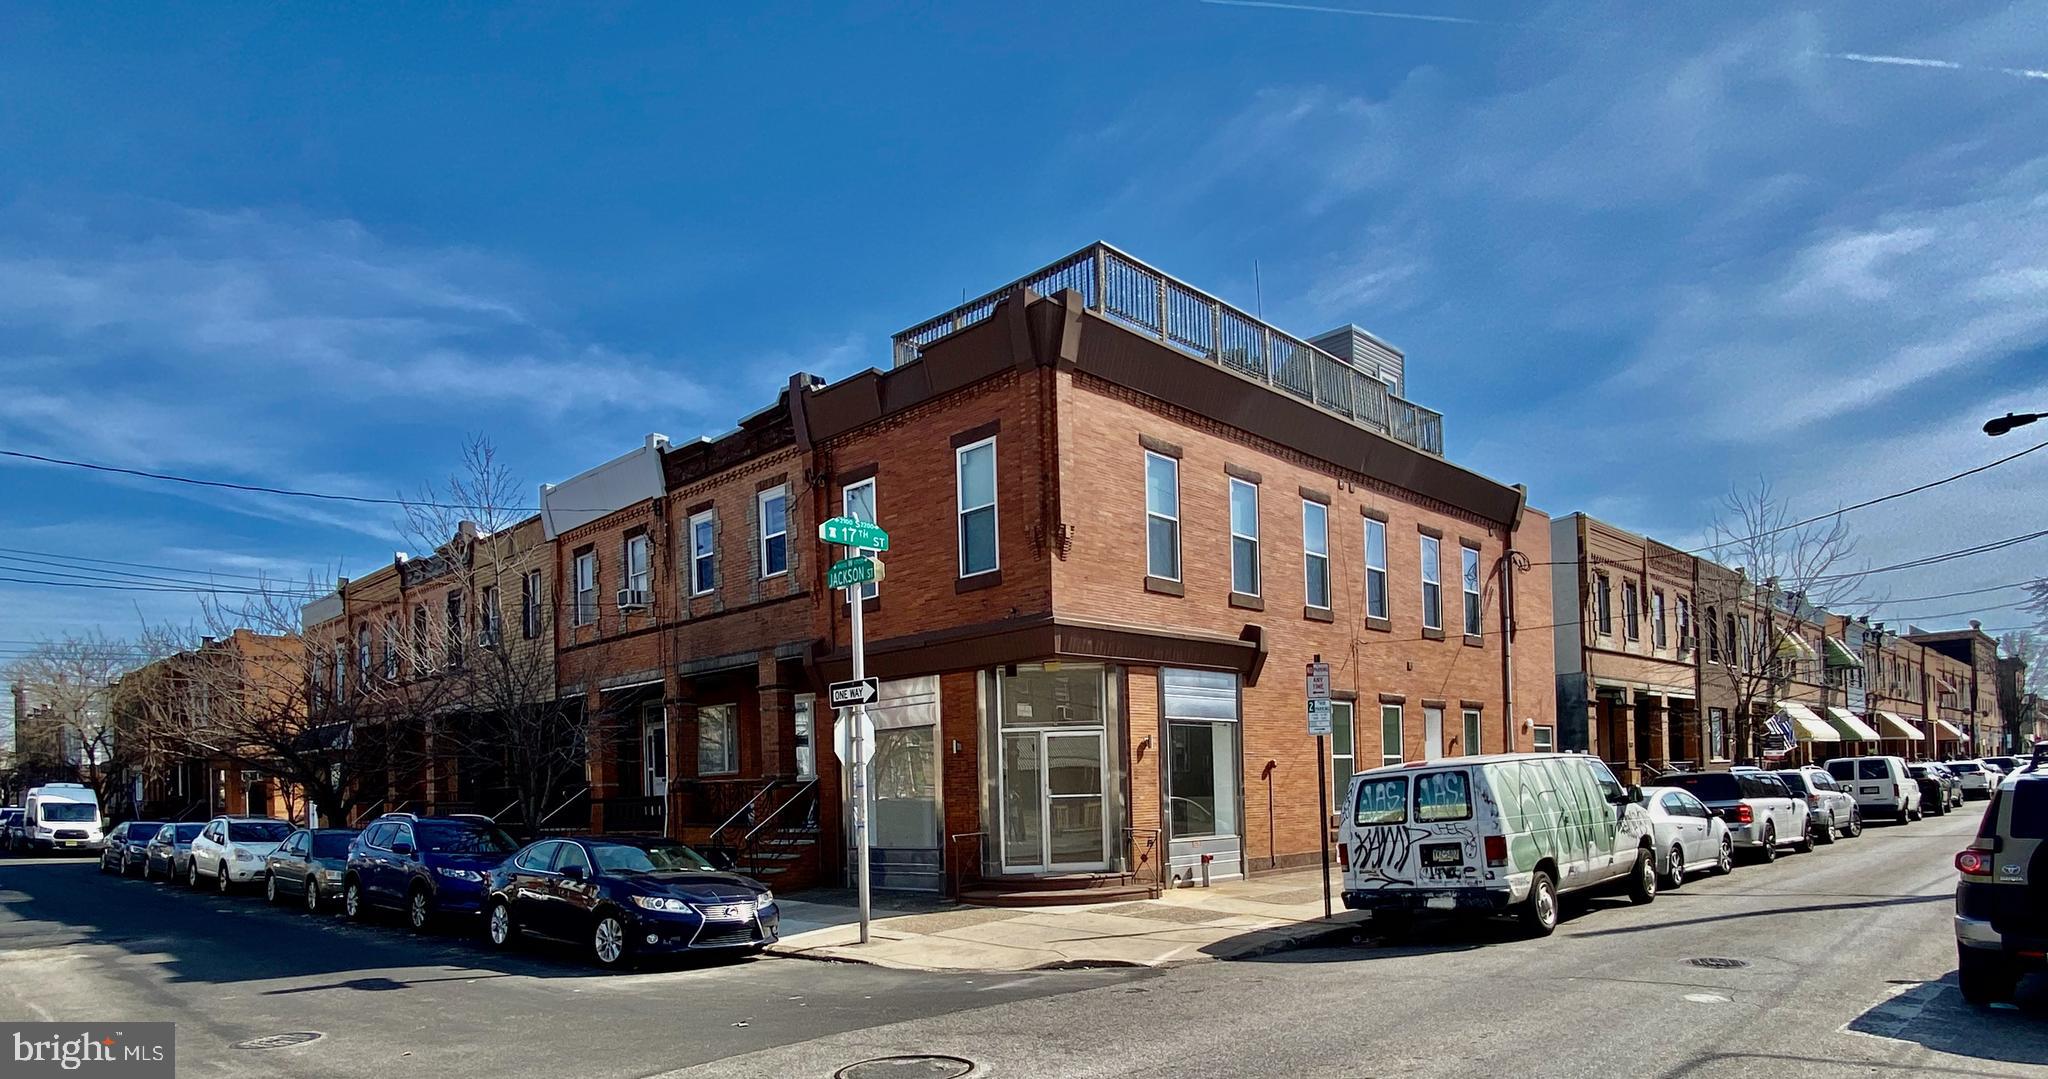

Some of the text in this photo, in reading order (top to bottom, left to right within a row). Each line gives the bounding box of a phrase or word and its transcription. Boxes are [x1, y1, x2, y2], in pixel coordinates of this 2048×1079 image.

[842, 527, 885, 548] 17TH ST
[829, 566, 865, 588] JACKSON
[866, 568, 874, 579] ST
[835, 687, 864, 700] ONE WAY
[1308, 701, 1314, 712] 2
